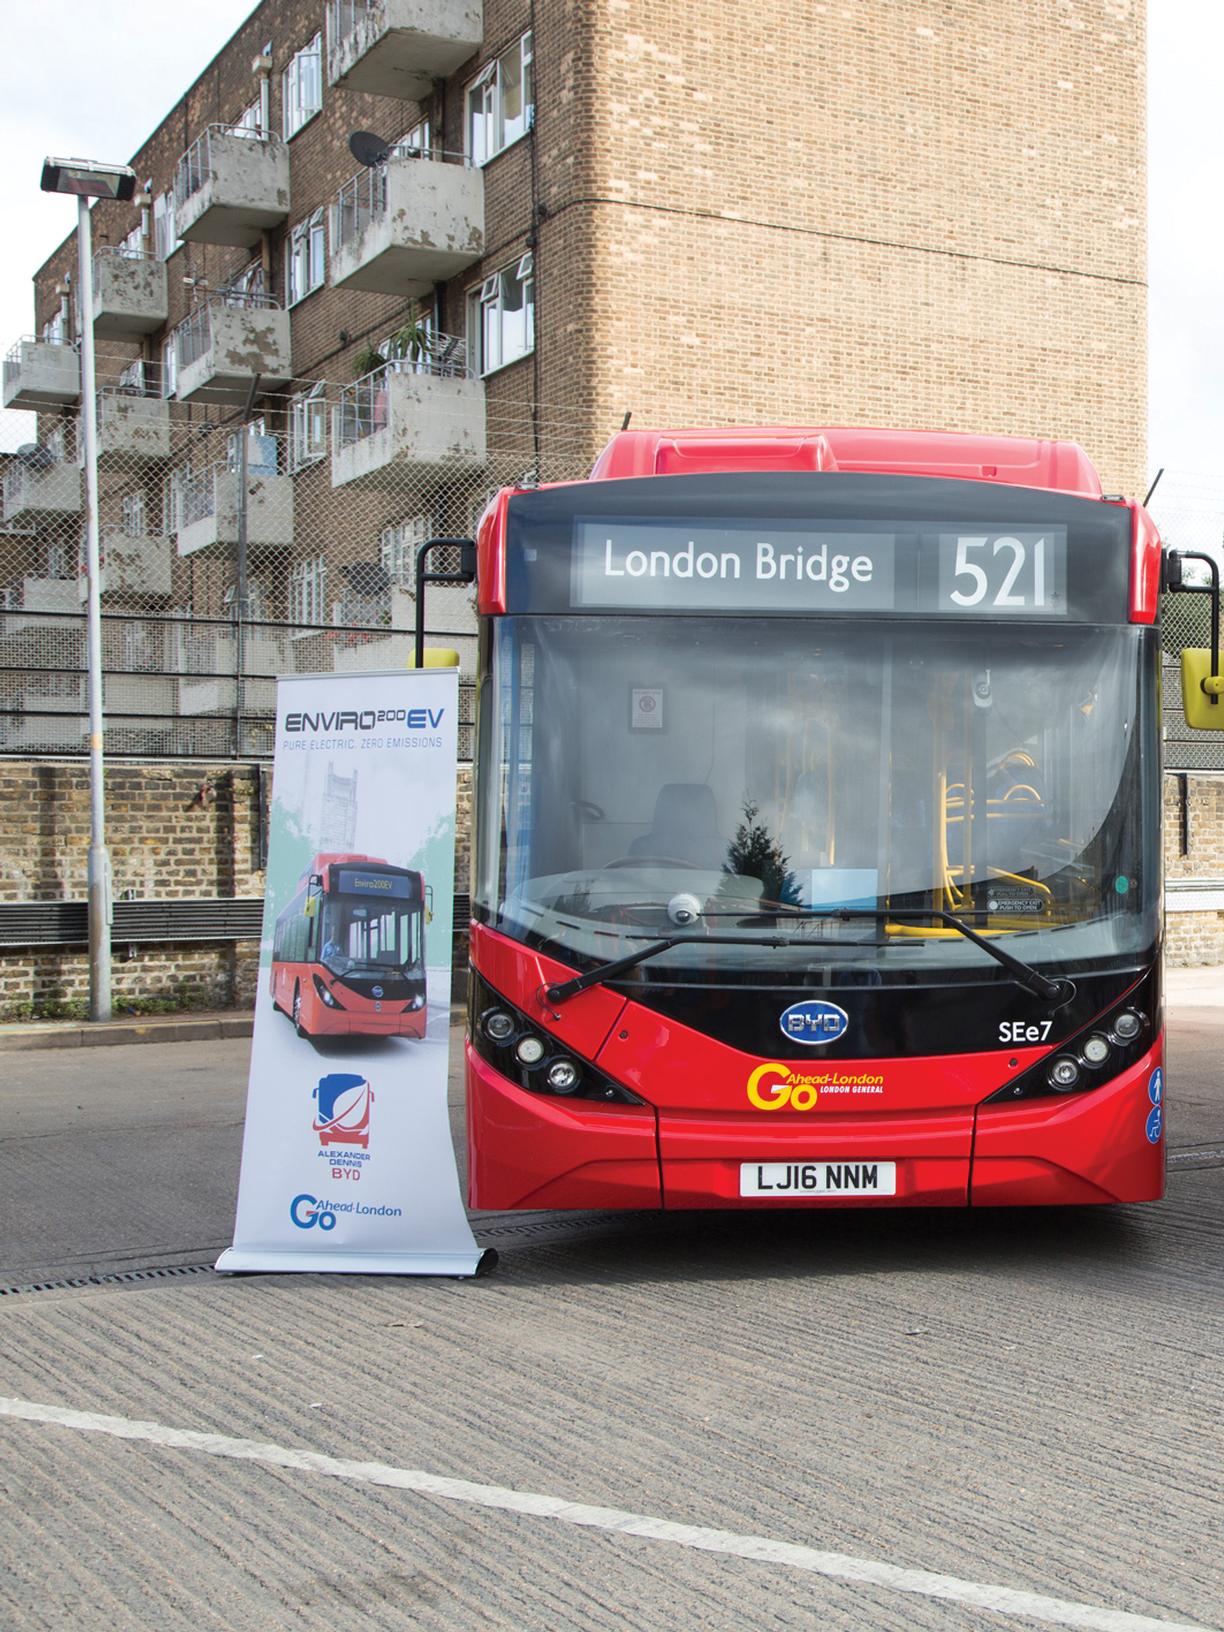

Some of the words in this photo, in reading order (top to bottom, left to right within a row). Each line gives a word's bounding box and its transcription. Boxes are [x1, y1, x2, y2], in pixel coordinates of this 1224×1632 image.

[604, 539, 740, 579] London
[756, 543, 873, 593] Bridge
[949, 536, 1046, 607] 521
[283, 740, 307, 750] PURE
[361, 738, 384, 749] ZERO
[387, 737, 443, 748] EMISSIONS
[788, 1013, 840, 1032] BYD
[998, 1021, 1053, 1043] SEe7
[747, 1063, 818, 1111] Go
[820, 1085, 850, 1094] LONDON
[852, 1086, 884, 1094] GENERAL
[317, 1150, 371, 1161] ALEXANDER
[329, 1159, 362, 1168] DENNIS
[332, 1168, 361, 1181] BYD
[758, 1165, 817, 1190] LJ16
[826, 1165, 878, 1189] NNM
[290, 1194, 336, 1231] Go
